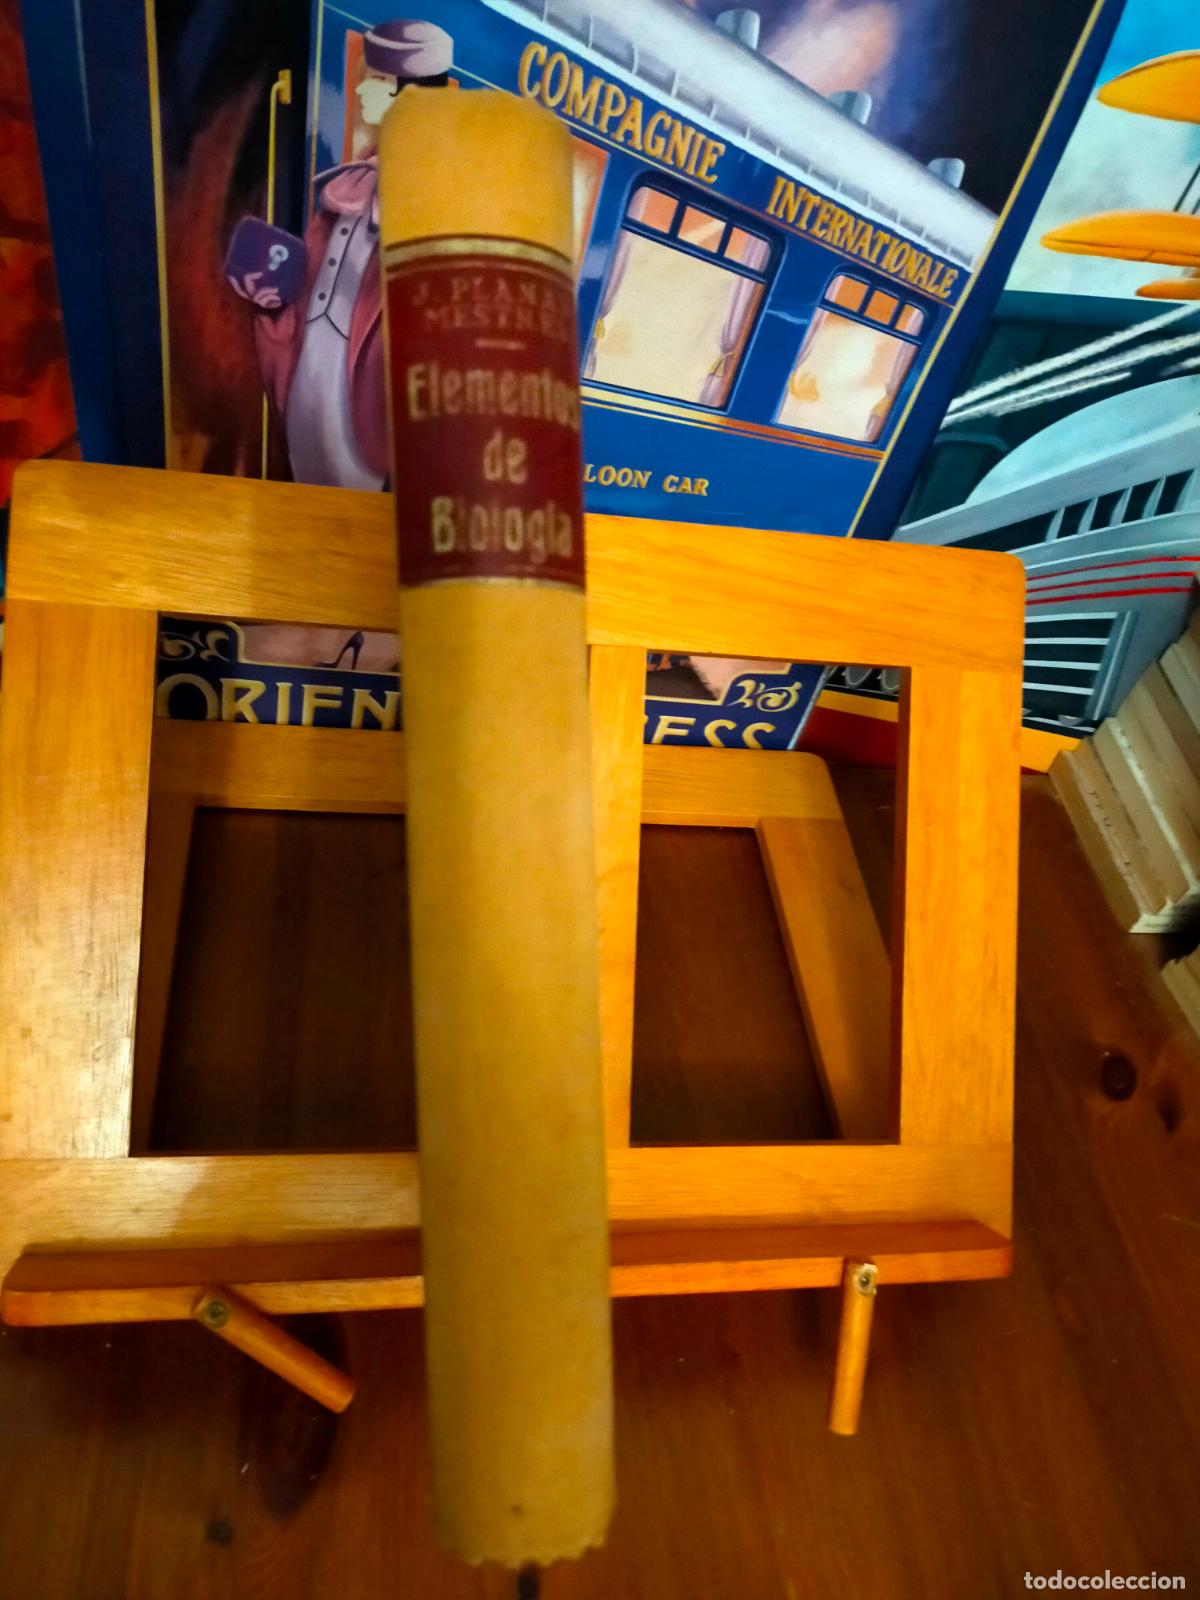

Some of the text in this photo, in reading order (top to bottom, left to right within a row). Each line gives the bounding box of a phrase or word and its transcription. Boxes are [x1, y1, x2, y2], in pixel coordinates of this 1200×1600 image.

[518, 42, 958, 299] COMPAGNIE INTERNATIONALE
[483, 428, 527, 485] de
[662, 474, 709, 497] CAR
